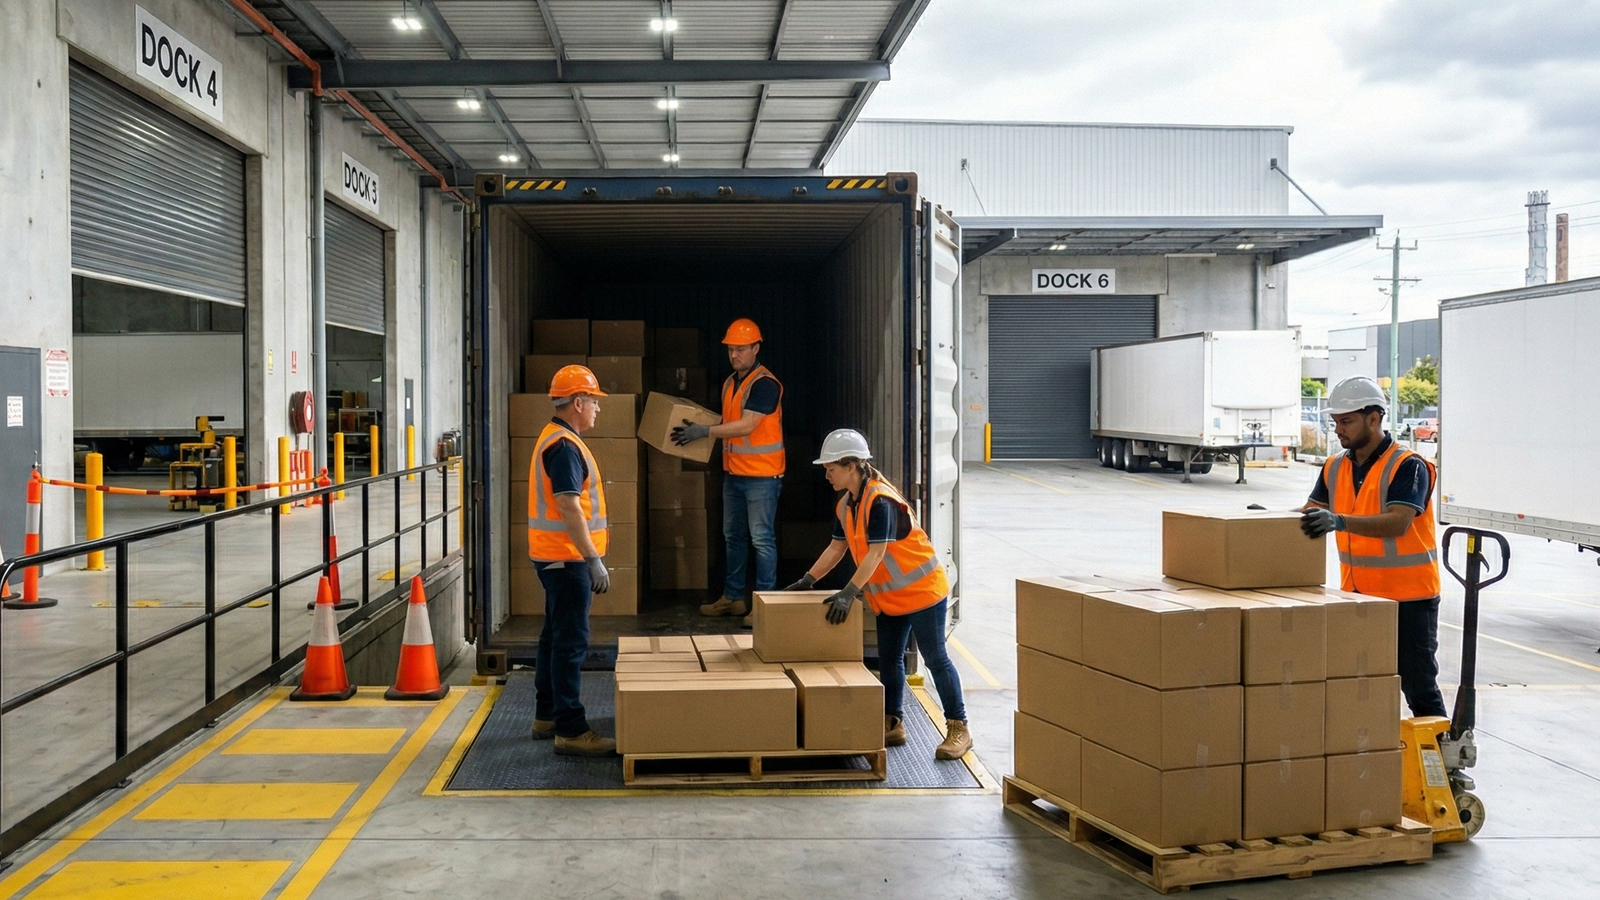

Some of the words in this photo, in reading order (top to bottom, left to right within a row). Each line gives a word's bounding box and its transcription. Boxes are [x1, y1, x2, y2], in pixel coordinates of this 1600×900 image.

[141, 22, 202, 99] DOCK
[207, 69, 218, 107] 4
[344, 161, 371, 202] DOCK
[1037, 273, 1093, 289] DOCK
[1098, 273, 1109, 289] 6
